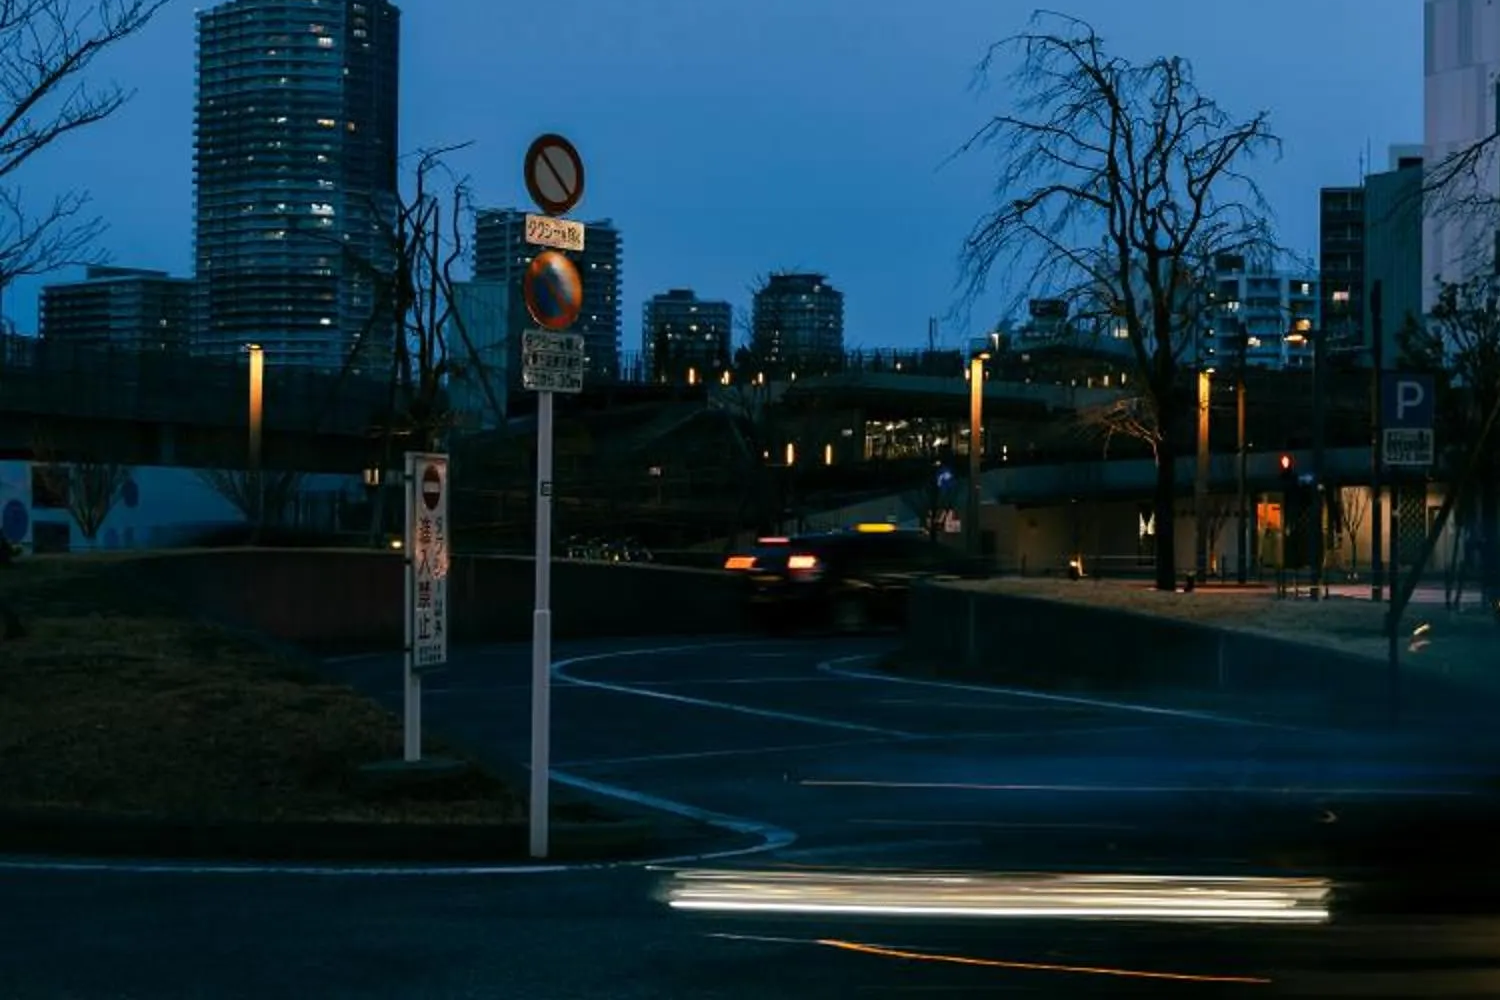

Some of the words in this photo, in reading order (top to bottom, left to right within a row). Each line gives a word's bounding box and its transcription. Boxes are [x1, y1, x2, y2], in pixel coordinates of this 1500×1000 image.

[1396, 380, 1425, 420] P
[418, 515, 432, 640] 進入禁止
